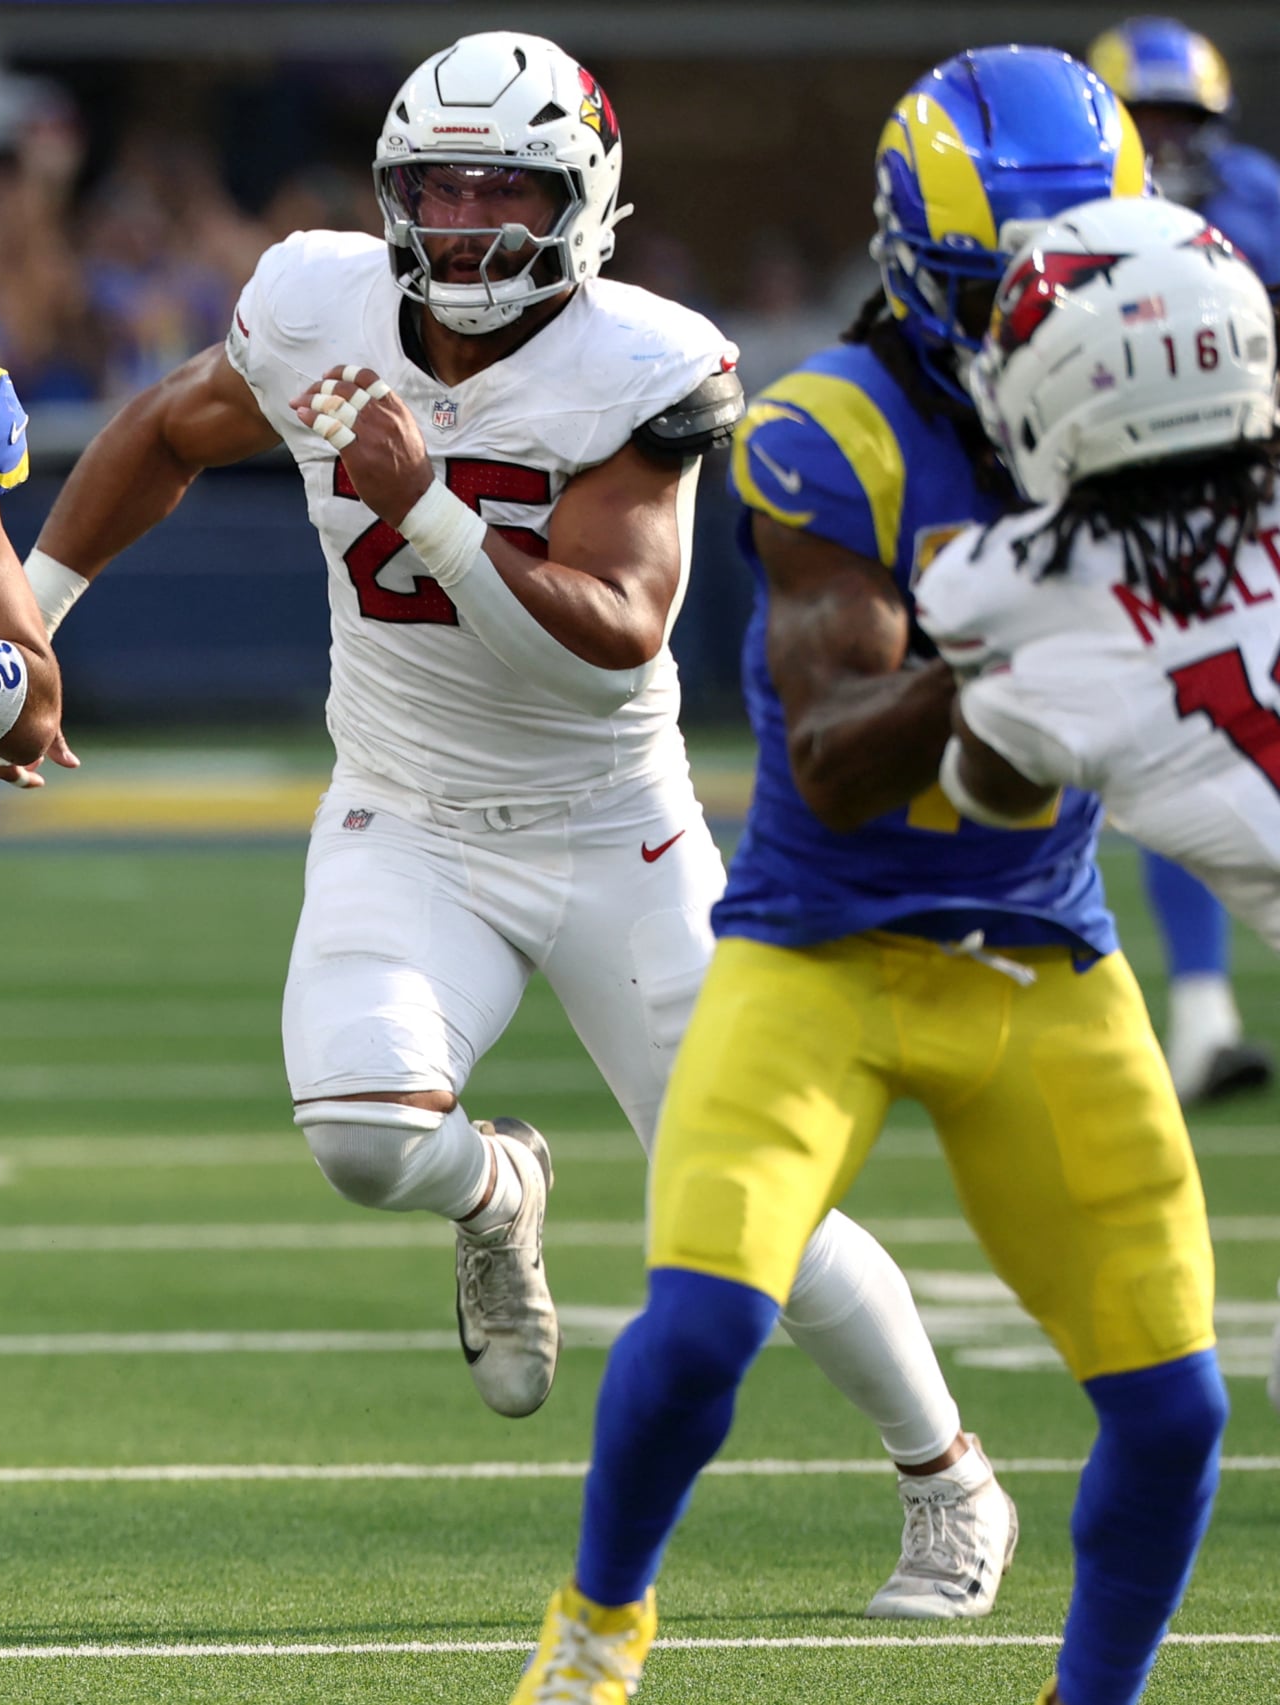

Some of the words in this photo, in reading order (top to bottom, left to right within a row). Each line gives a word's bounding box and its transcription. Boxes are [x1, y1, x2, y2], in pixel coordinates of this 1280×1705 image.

[432, 126, 489, 134] CARDINALS
[1160, 330, 1218, 378] 16
[434, 412, 454, 425] NFL
